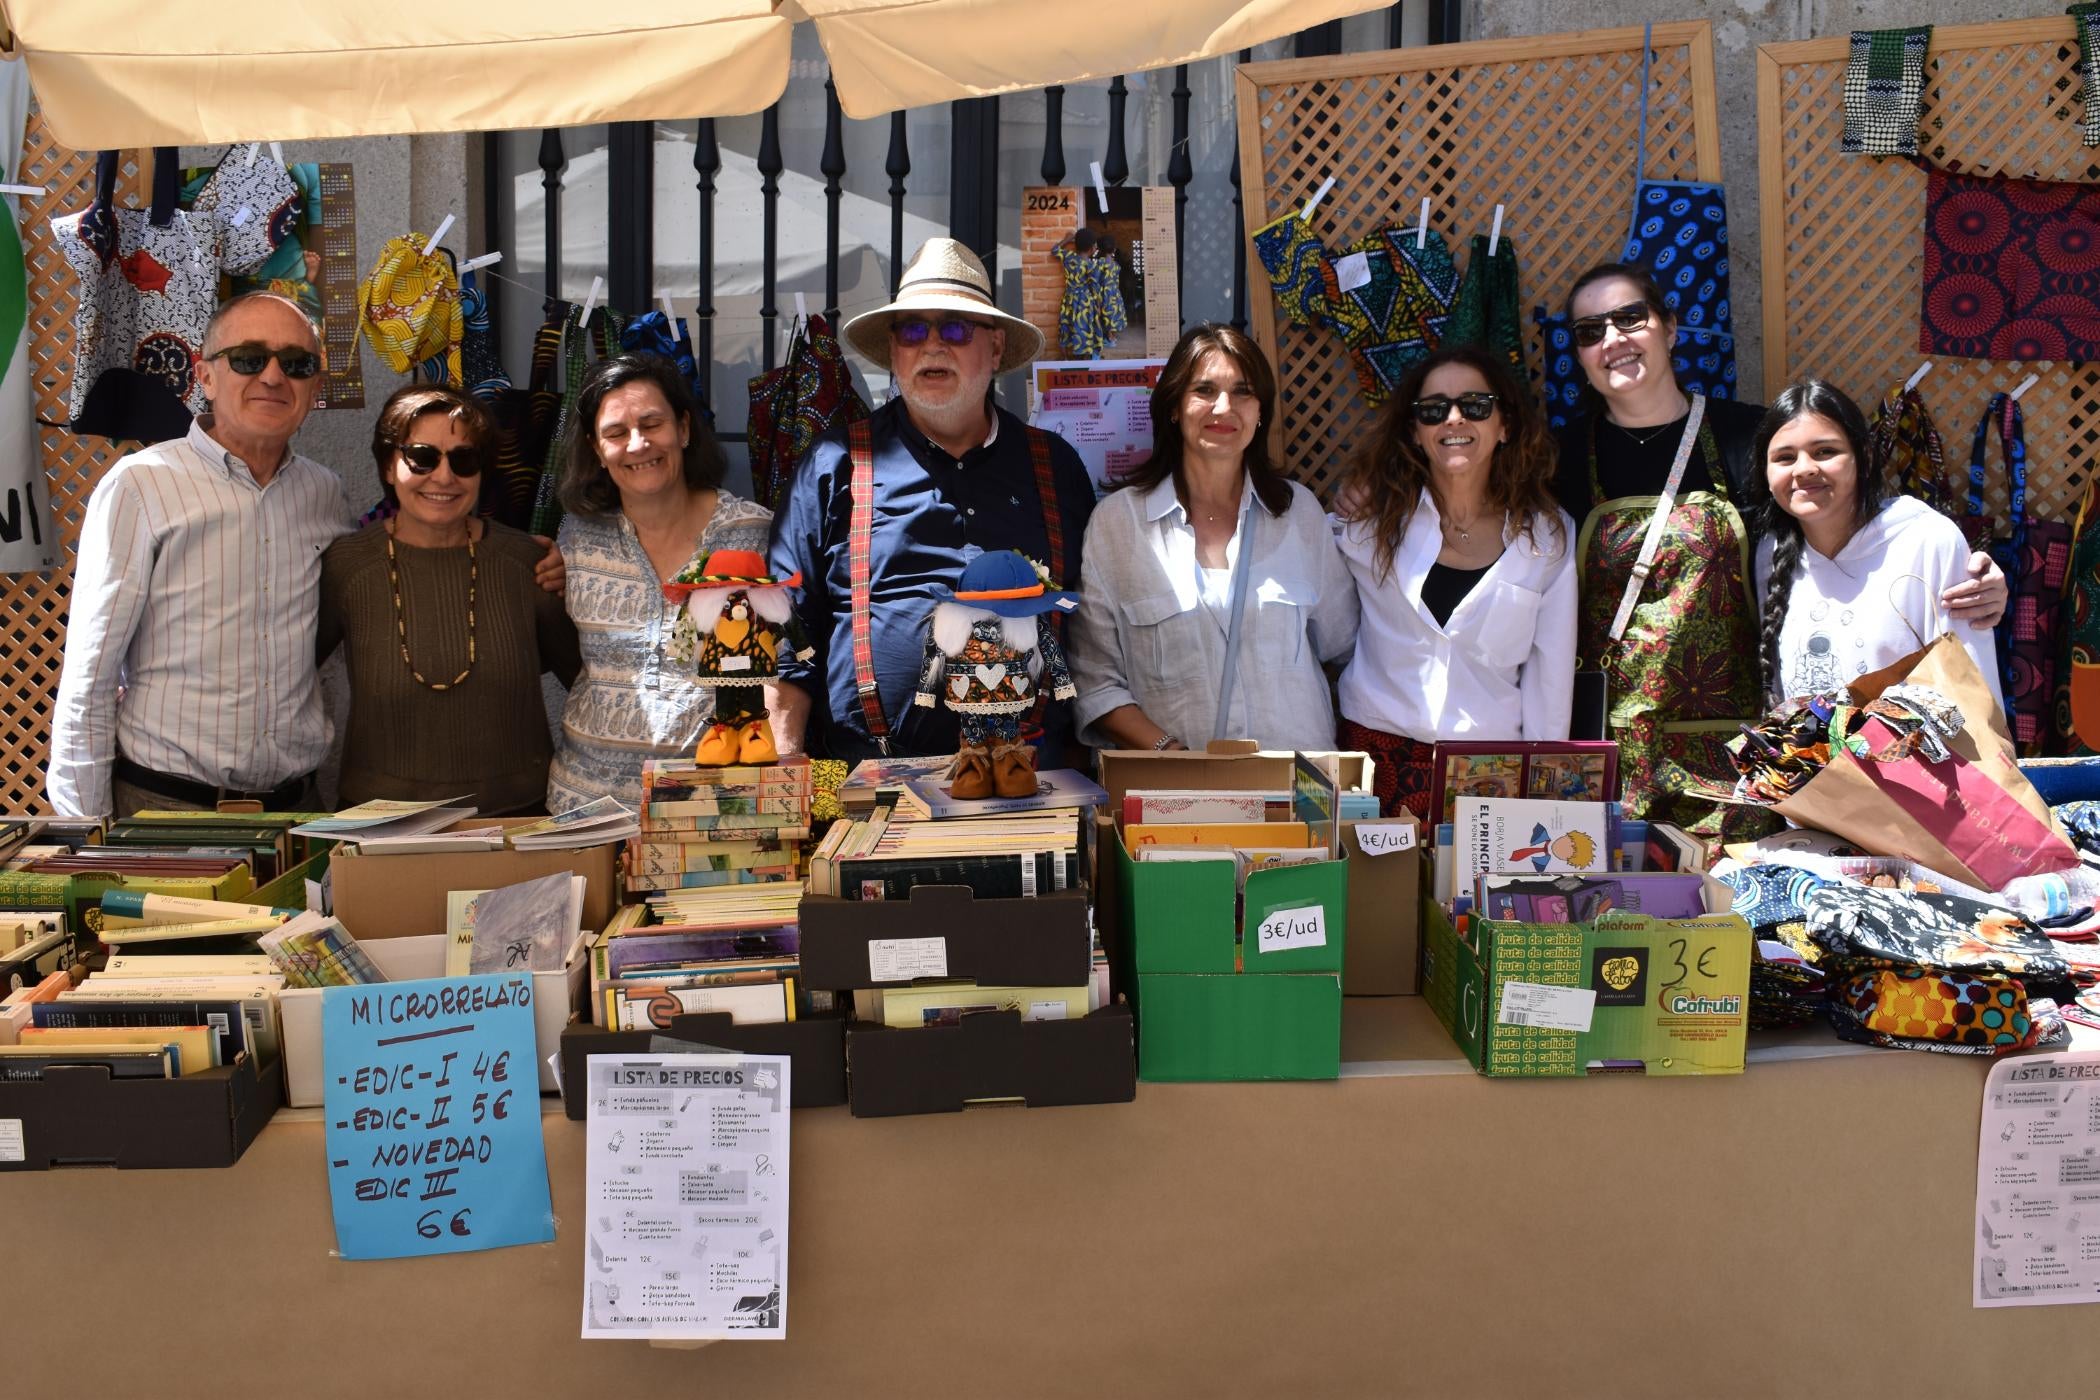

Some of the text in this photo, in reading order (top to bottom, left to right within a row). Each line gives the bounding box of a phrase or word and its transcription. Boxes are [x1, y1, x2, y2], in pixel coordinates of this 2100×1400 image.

[1028, 195, 1070, 210] 2024
[1054, 373, 1149, 385] LISTA DE PRECIOS
[1496, 816, 1504, 842] BORJA
[1362, 832, 1408, 848] 4€/ud
[1480, 804, 1489, 872] EL PRINCIP
[1264, 916, 1317, 939] 3€/ud
[1498, 934, 1582, 944] fruta de calidad
[1497, 947, 1581, 958] fruta de calidad
[1496, 960, 1580, 971] fruta de calidad
[1527, 974, 1540, 983] de
[1542, 974, 1579, 983] calidad
[352, 980, 530, 1024] MICRORRELATO
[1672, 996, 1740, 1014] Cofrubi
[1494, 1026, 1521, 1036] fruta
[1524, 1026, 1537, 1036] de
[1492, 1038, 1576, 1050] fruta de calidad
[1492, 1051, 1576, 1063] fruta de calidad
[472, 1051, 510, 1084] 4€
[2011, 1068, 2044, 1080] LISTA
[2049, 1067, 2065, 1078] DE
[614, 1070, 744, 1085] LISTA DE PRECIOS
[472, 1090, 512, 1124] 5€
[372, 1135, 492, 1168] NOVEDAD
[356, 1168, 459, 1201] EDIC III
[416, 1208, 472, 1239] 6€
